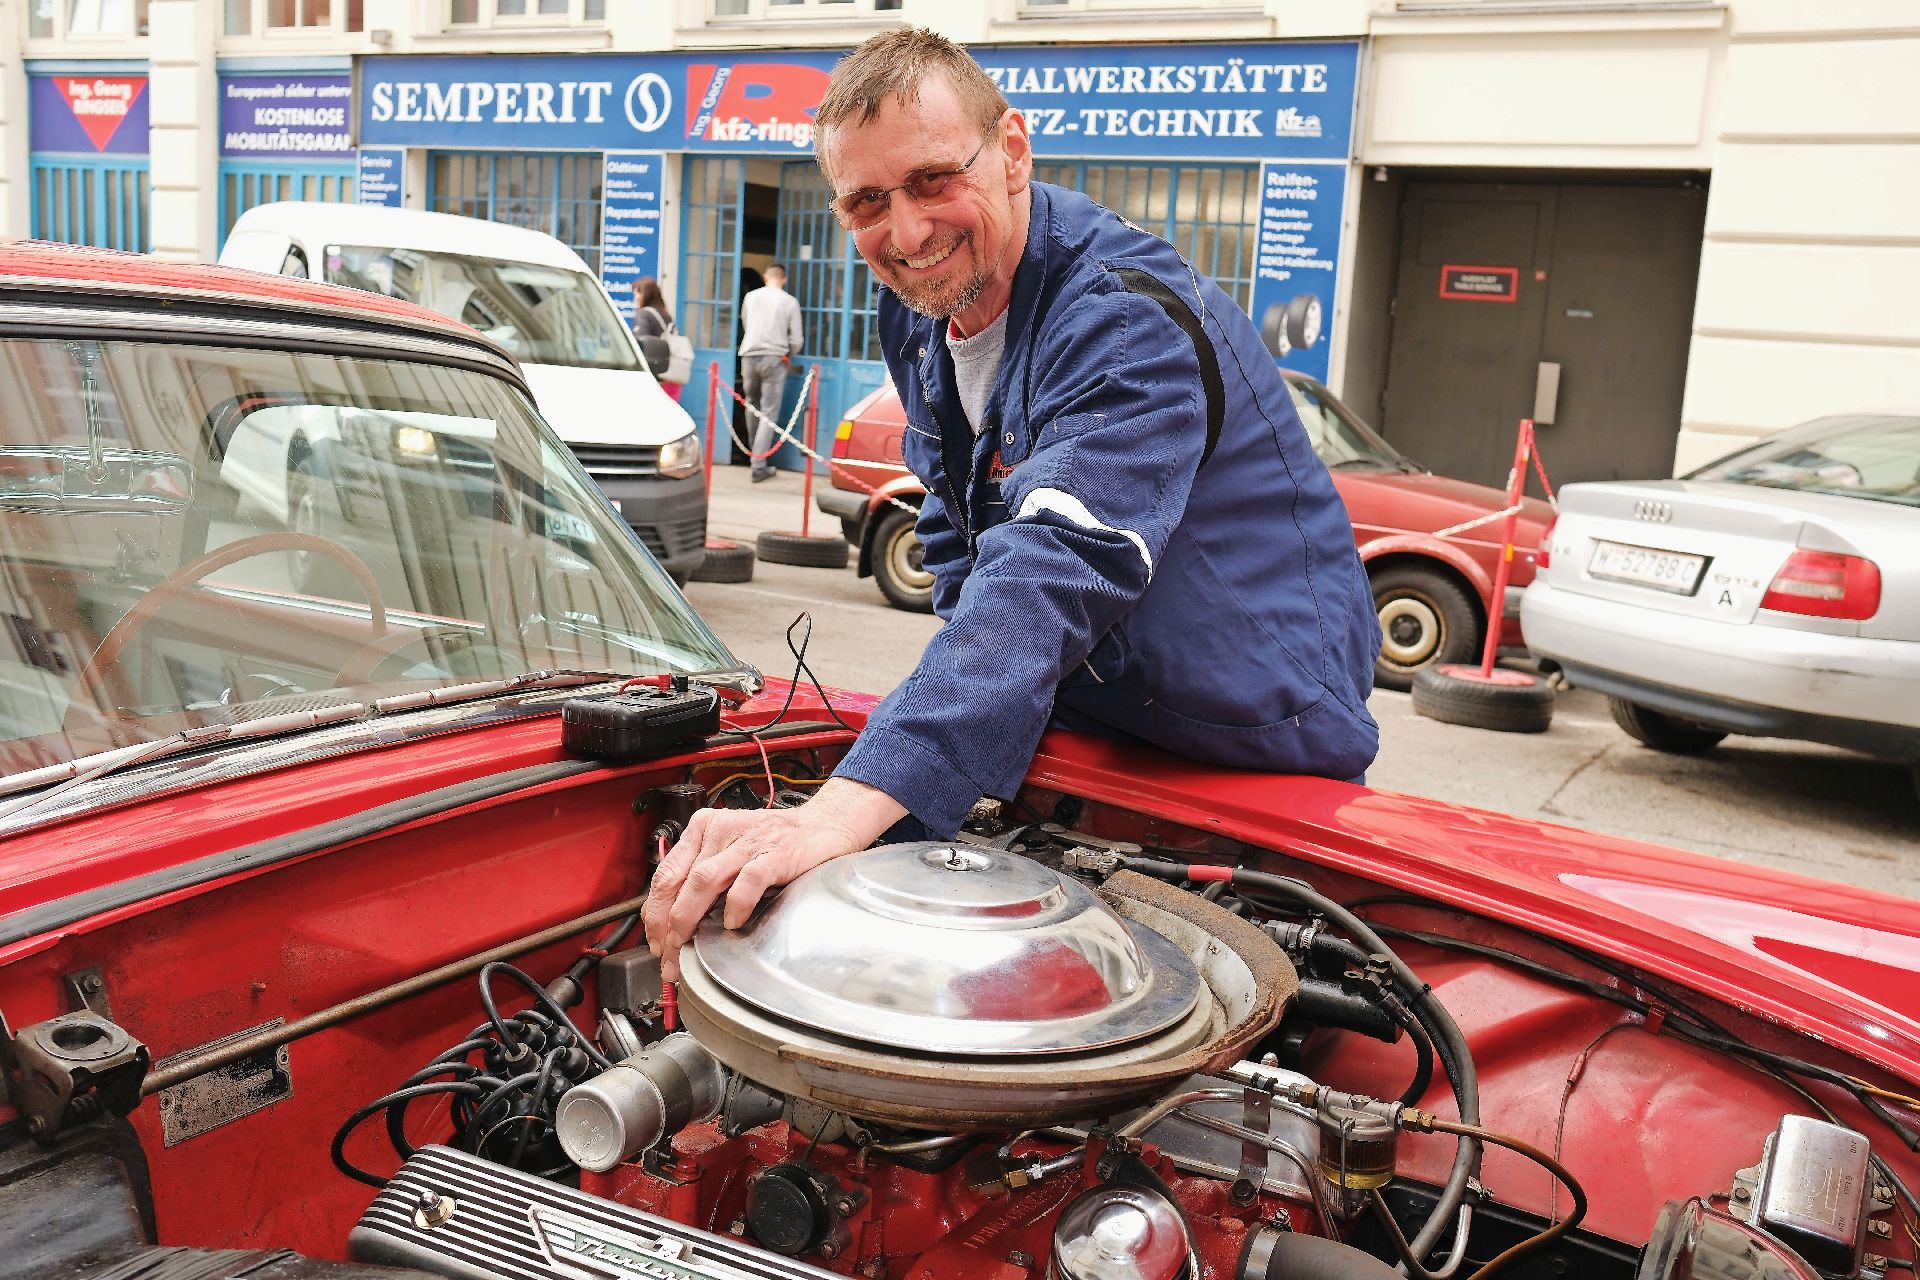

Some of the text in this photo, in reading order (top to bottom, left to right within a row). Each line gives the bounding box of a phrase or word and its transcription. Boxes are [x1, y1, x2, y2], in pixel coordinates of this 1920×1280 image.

[702, 67, 733, 109] Georg
[371, 81, 613, 124] SEMPERIT
[254, 107, 345, 127] KOSTENLOSE
[607, 161, 650, 174] Oldtimer
[1267, 171, 1319, 187] Reifen-
[1265, 186, 1318, 201] service
[605, 206, 660, 220] Reparaturen
[1621, 551, 1680, 579] 52788
[1718, 589, 1733, 606] A
